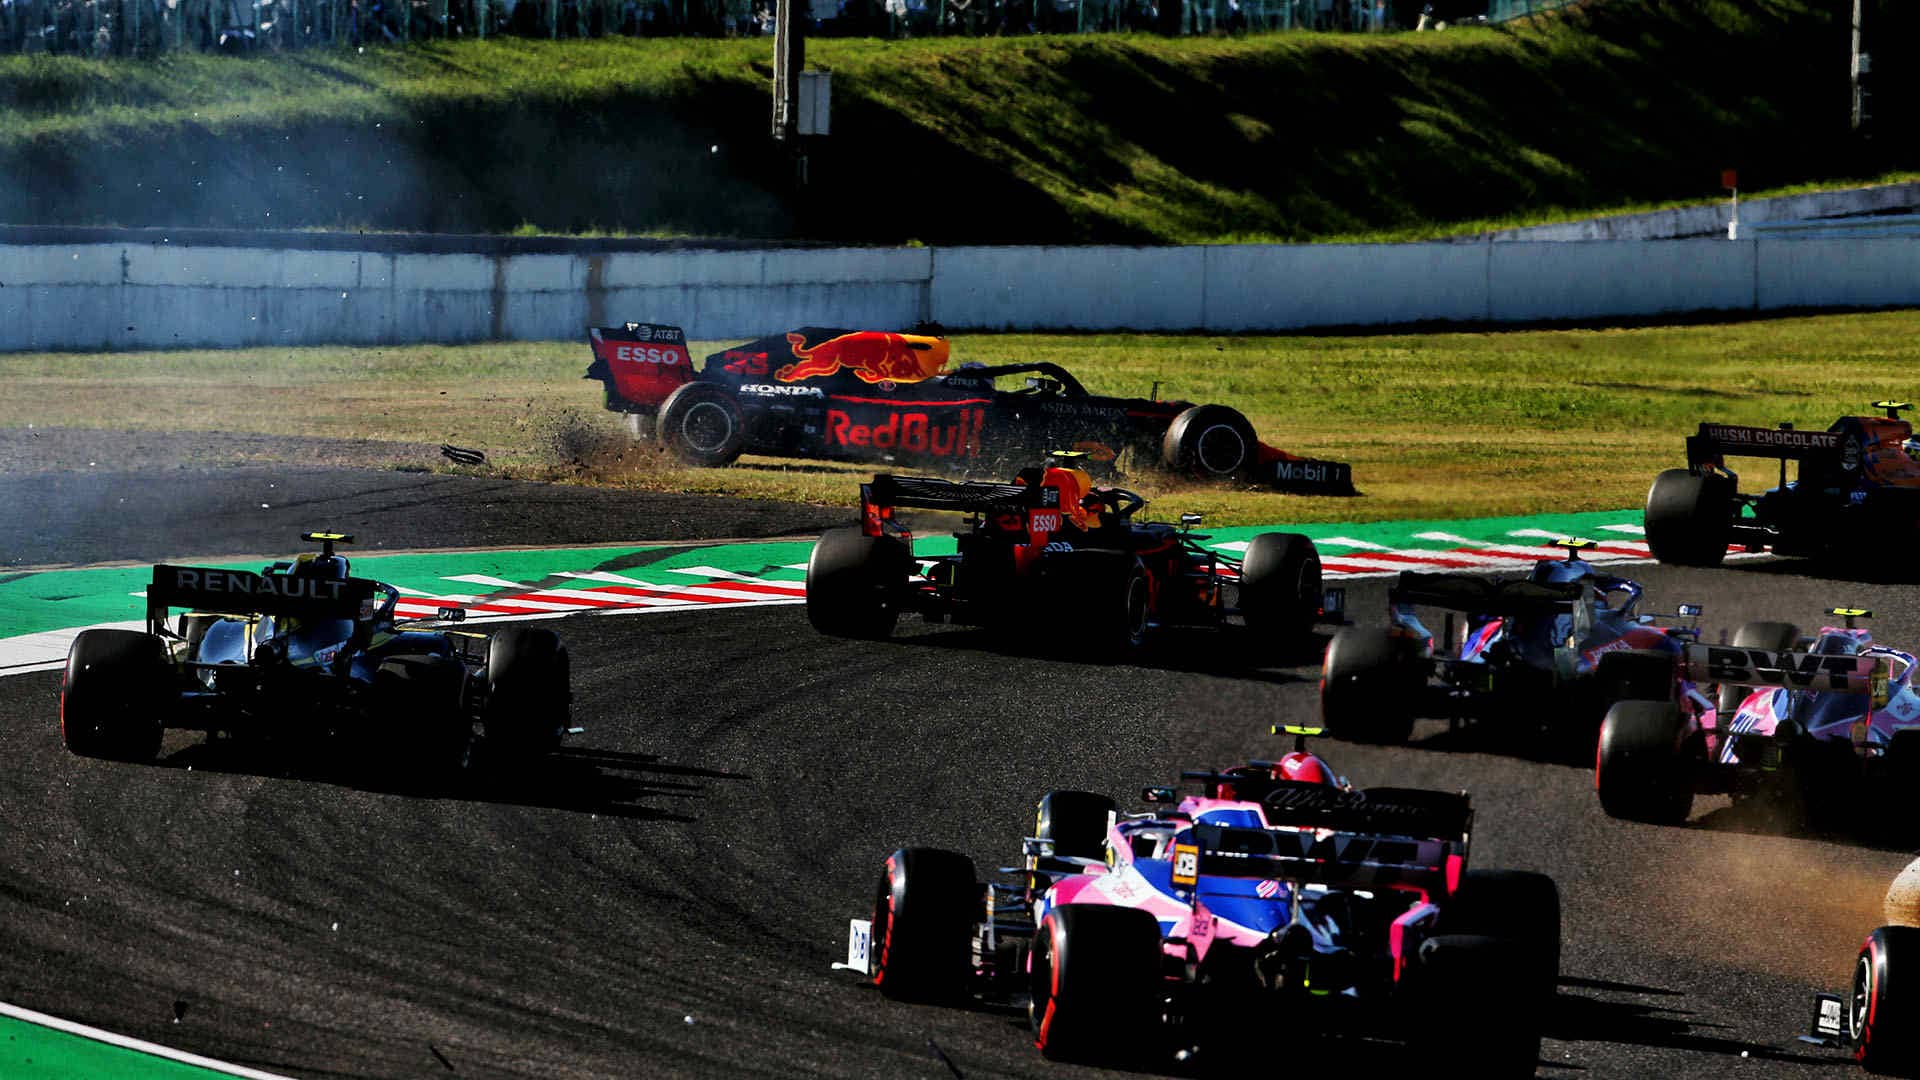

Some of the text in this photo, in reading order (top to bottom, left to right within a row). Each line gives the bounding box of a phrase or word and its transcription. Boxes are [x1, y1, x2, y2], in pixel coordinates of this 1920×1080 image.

[653, 329, 681, 340] AT&T
[617, 346, 679, 365] ESSO
[740, 384, 824, 399] HONDA
[1706, 427, 1838, 449] HUSKI CHOCOLATE
[1276, 461, 1327, 482] Mobil
[1033, 515, 1057, 532] ESSO
[175, 569, 347, 600] RENAULT
[1708, 648, 1857, 690] BWT
